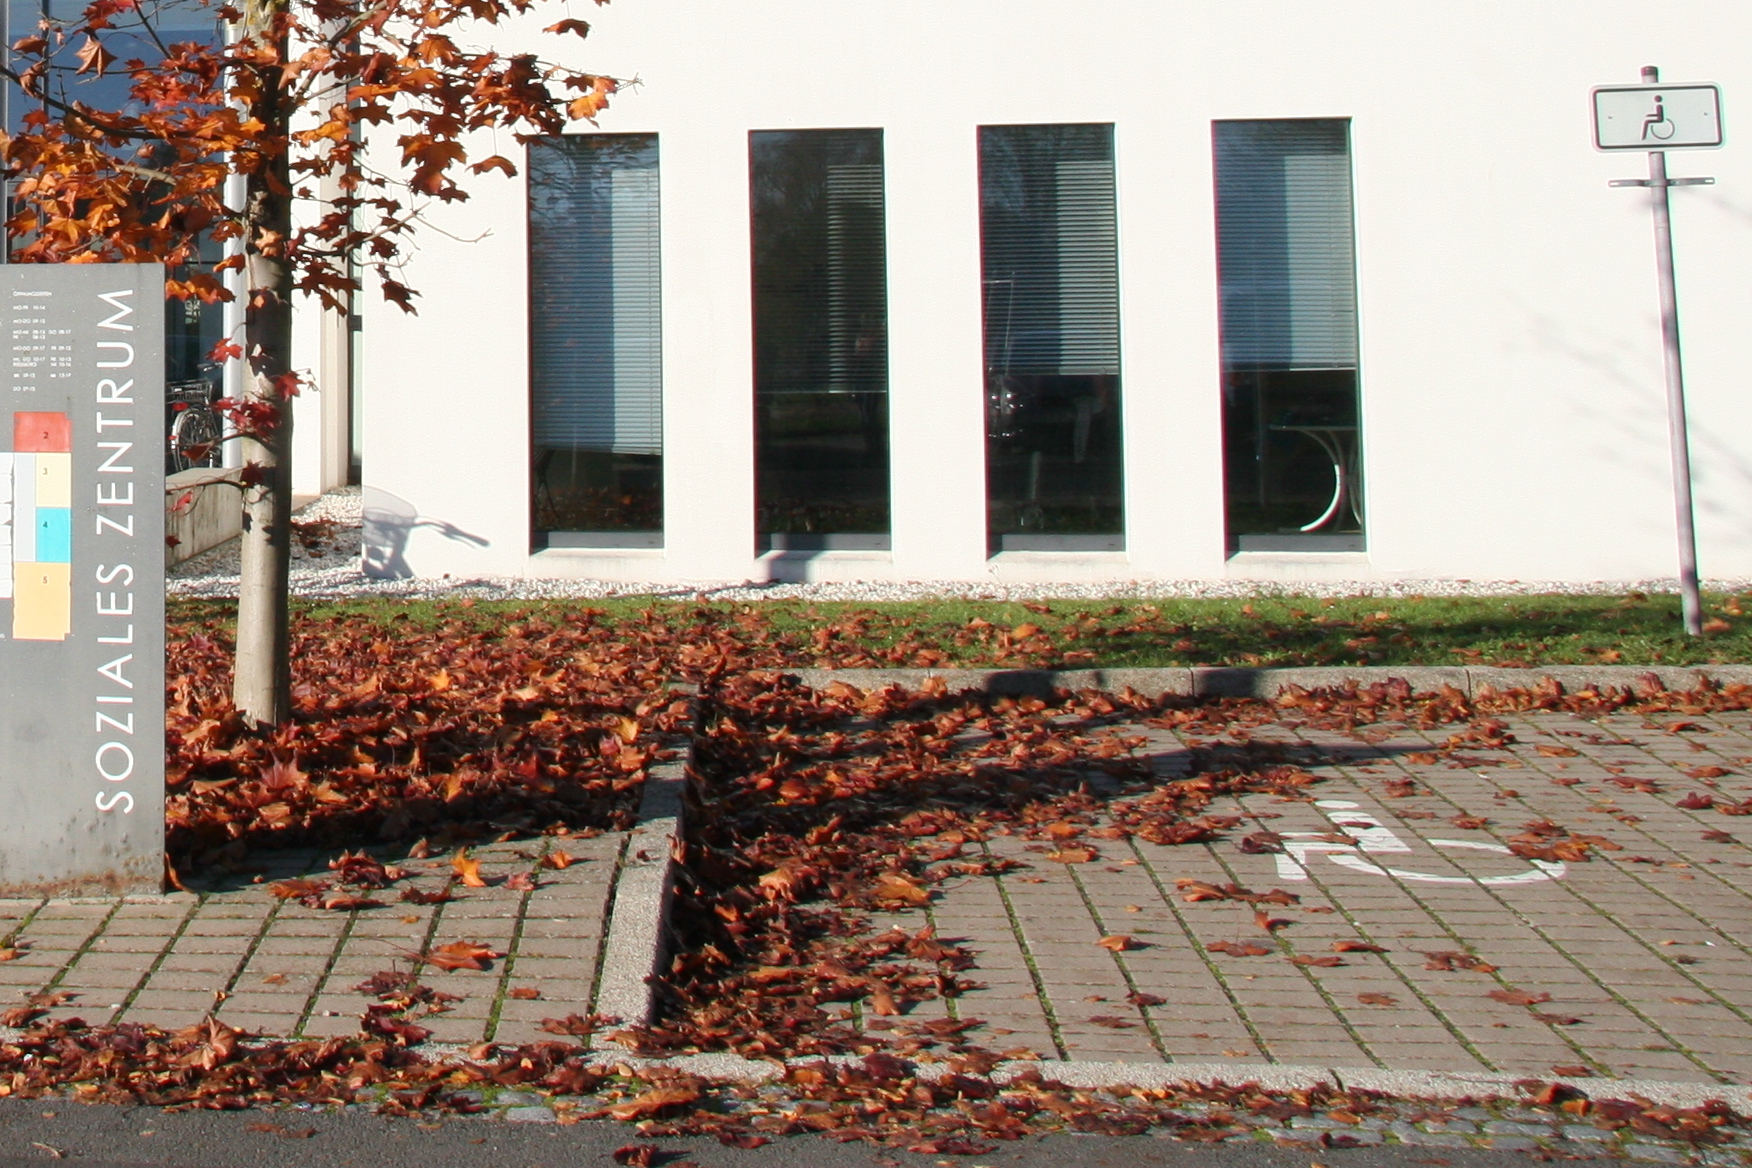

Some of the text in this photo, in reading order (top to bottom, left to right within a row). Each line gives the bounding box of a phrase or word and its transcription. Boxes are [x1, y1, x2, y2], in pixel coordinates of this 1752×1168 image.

[43, 431, 49, 440] 2
[43, 467, 49, 476] 3
[42, 521, 49, 529] 4
[93, 288, 135, 816] SOZIALES ZENTRUM
[43, 575, 48, 584] 5
